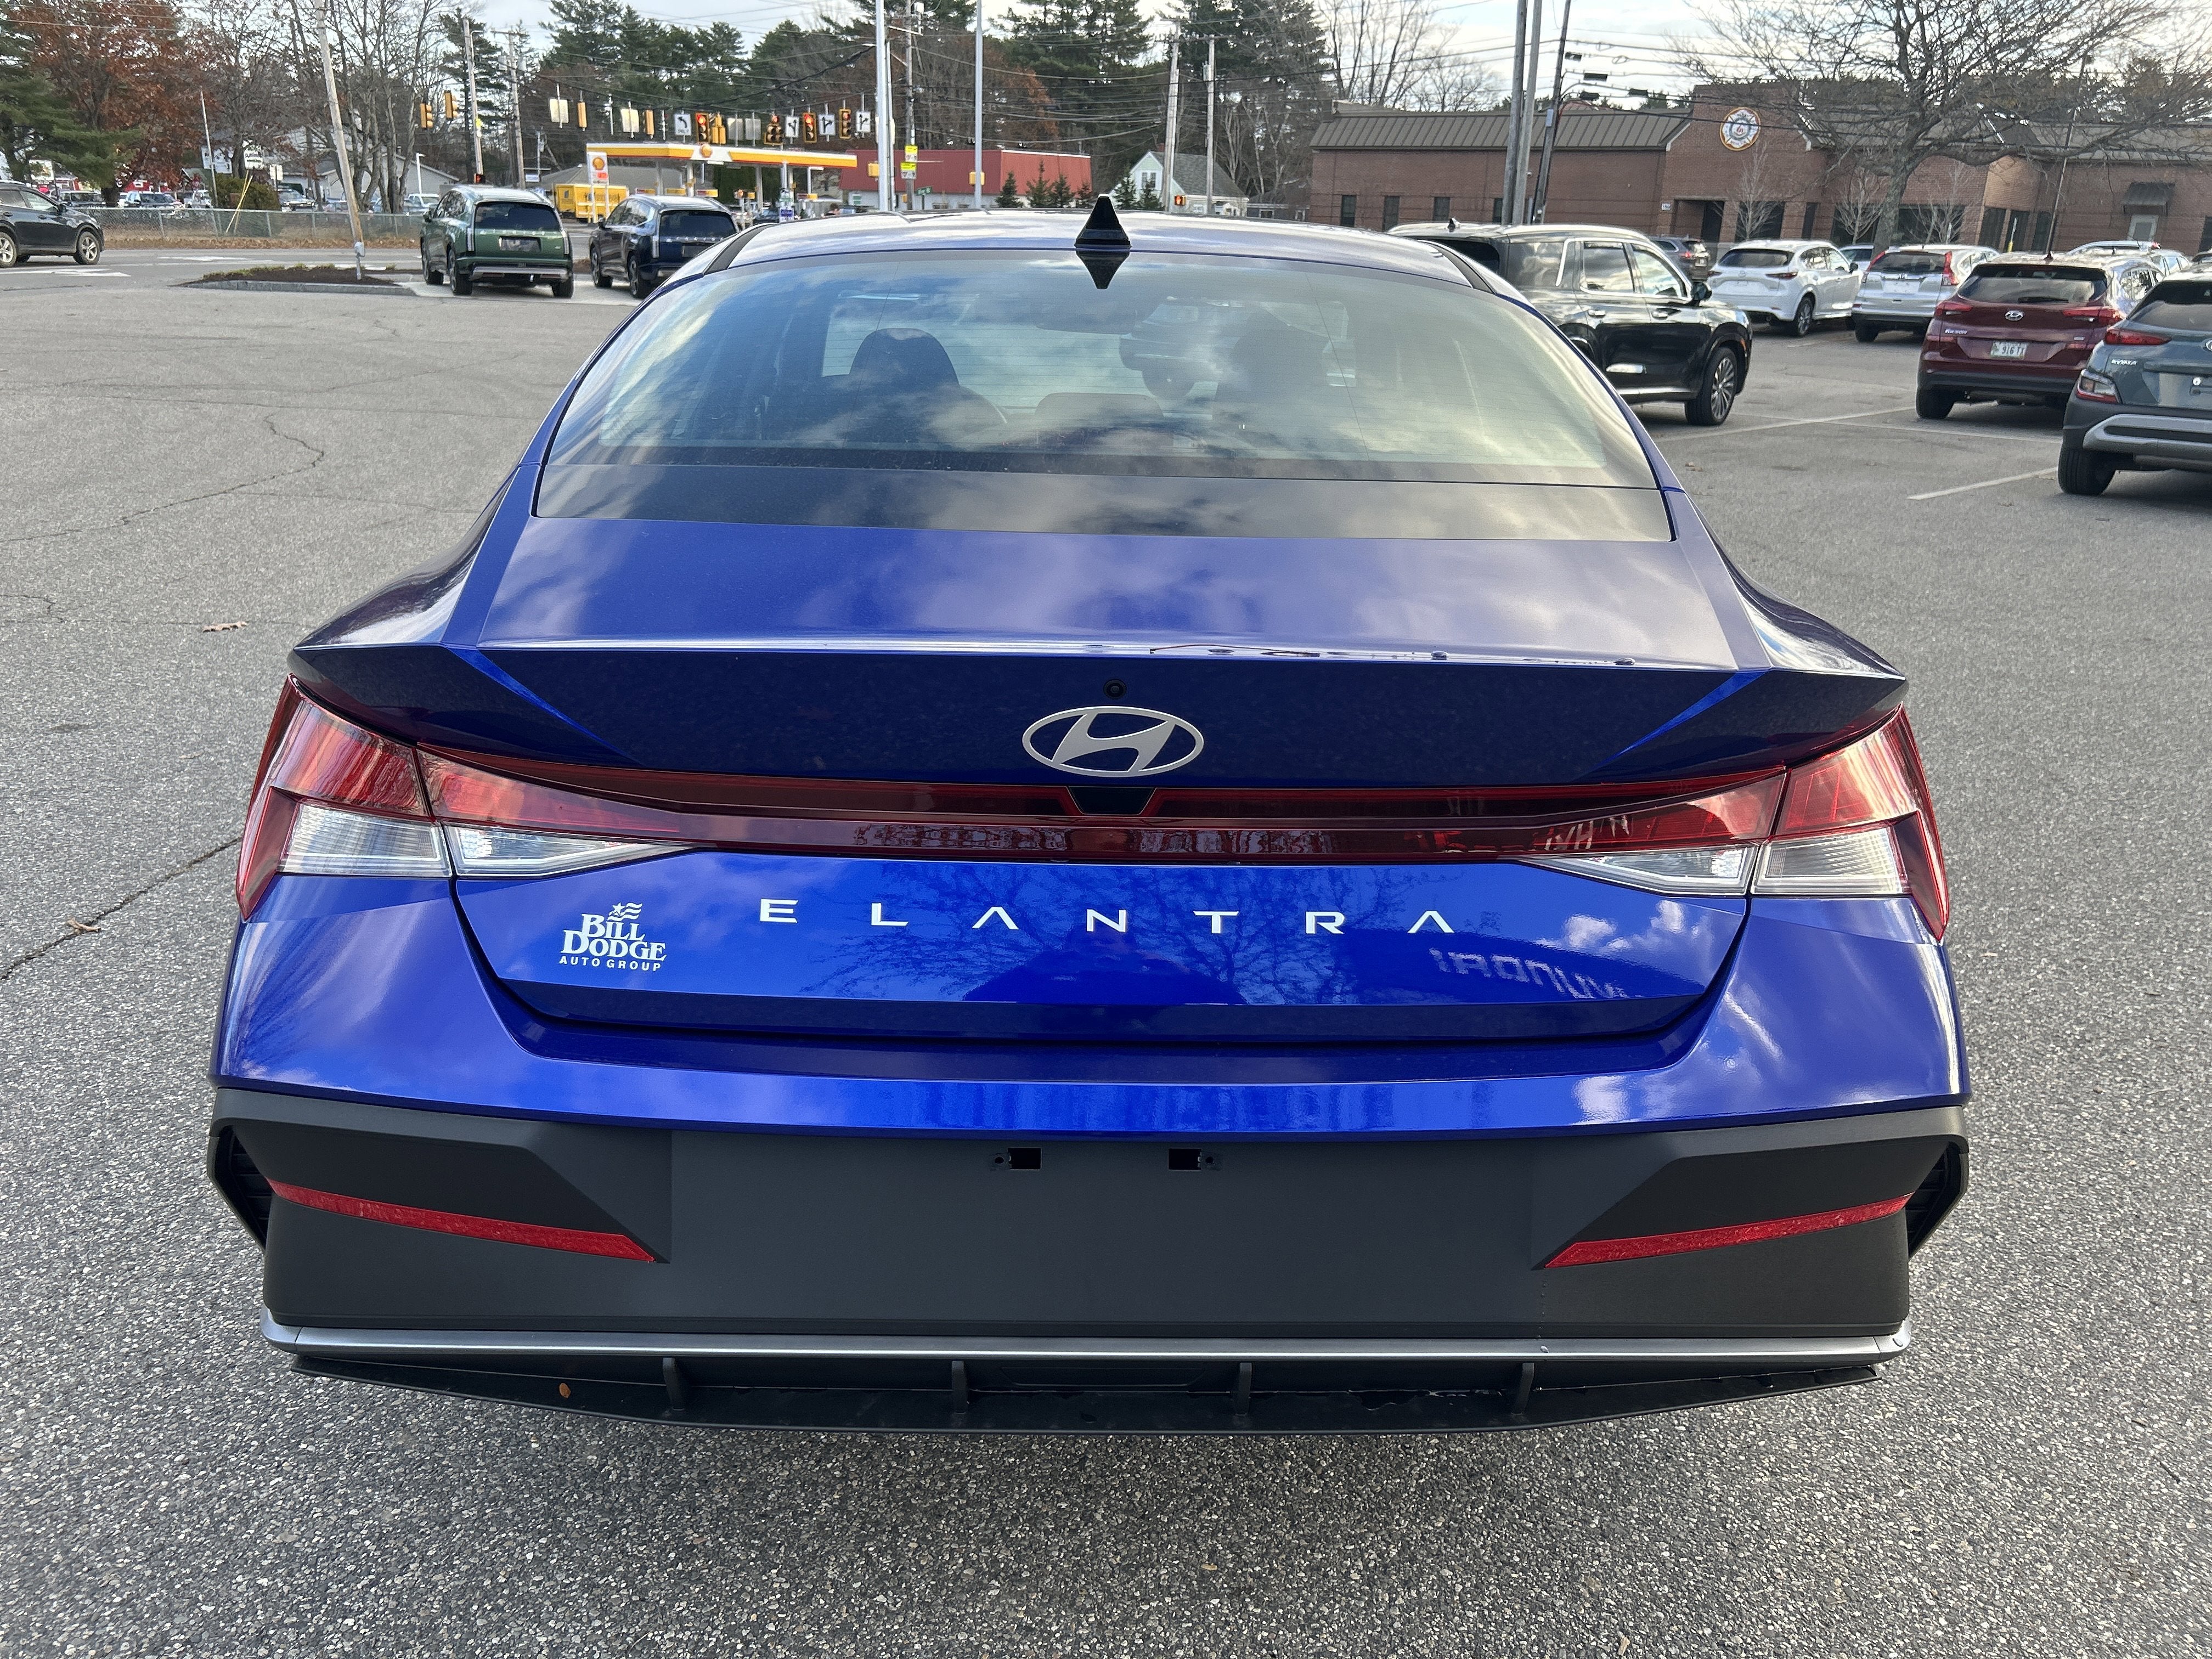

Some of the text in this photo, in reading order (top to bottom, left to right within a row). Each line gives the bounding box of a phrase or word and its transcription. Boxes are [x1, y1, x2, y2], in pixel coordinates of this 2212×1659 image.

[582, 913, 645, 941] BILL
[759, 898, 1455, 935] ELANTRA
[560, 929, 667, 962] DODGE
[558, 955, 662, 972] AUTO GROUP
